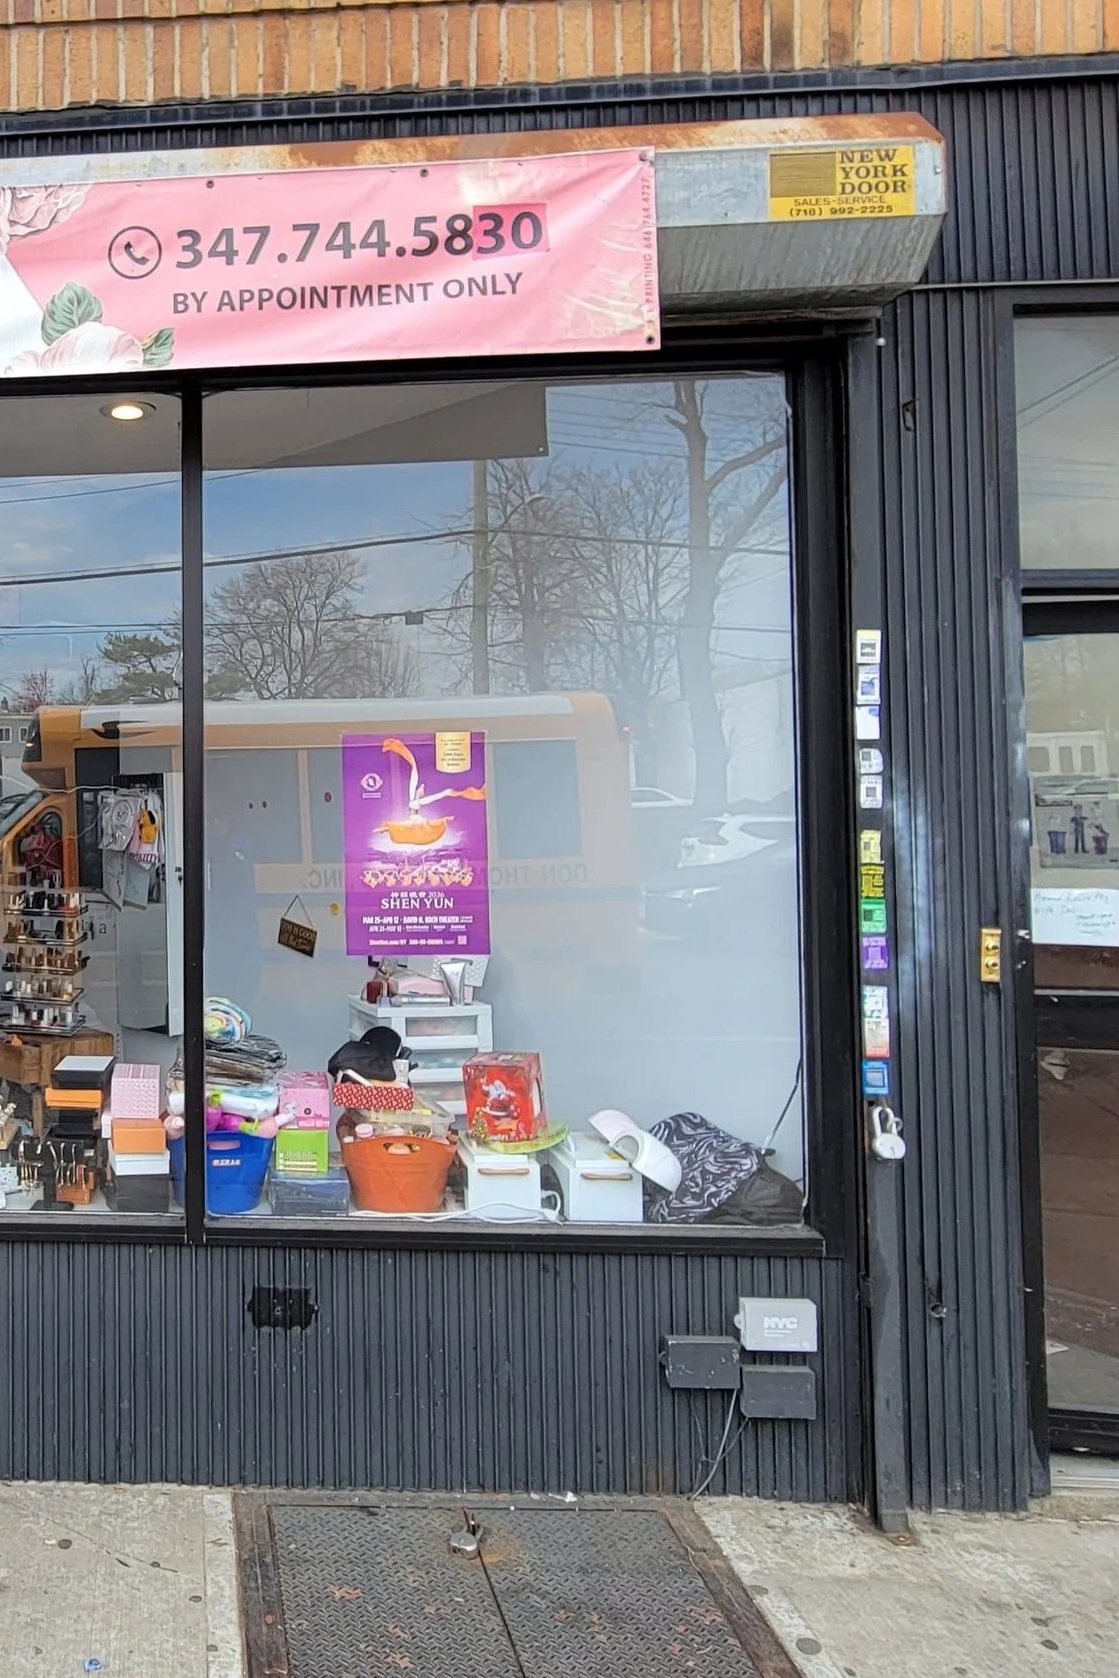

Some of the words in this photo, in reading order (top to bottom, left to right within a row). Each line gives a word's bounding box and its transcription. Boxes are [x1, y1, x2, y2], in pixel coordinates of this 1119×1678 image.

[839, 148, 898, 164] NEW
[840, 164, 909, 180] YORK
[839, 179, 907, 196] DOOR
[793, 195, 887, 207] SALES-SERVICE
[789, 207, 823, 217] (718)
[829, 204, 894, 216] 992-2225
[175, 210, 544, 270] 347.744.5830
[644, 254, 654, 304] PRINTING
[172, 292, 209, 315] BY
[217, 281, 435, 313] APPOINTMENT
[442, 271, 524, 300] ONLY
[381, 898, 420, 910] SHEN
[424, 898, 454, 909] YUN
[763, 1316, 798, 1330] NYC
